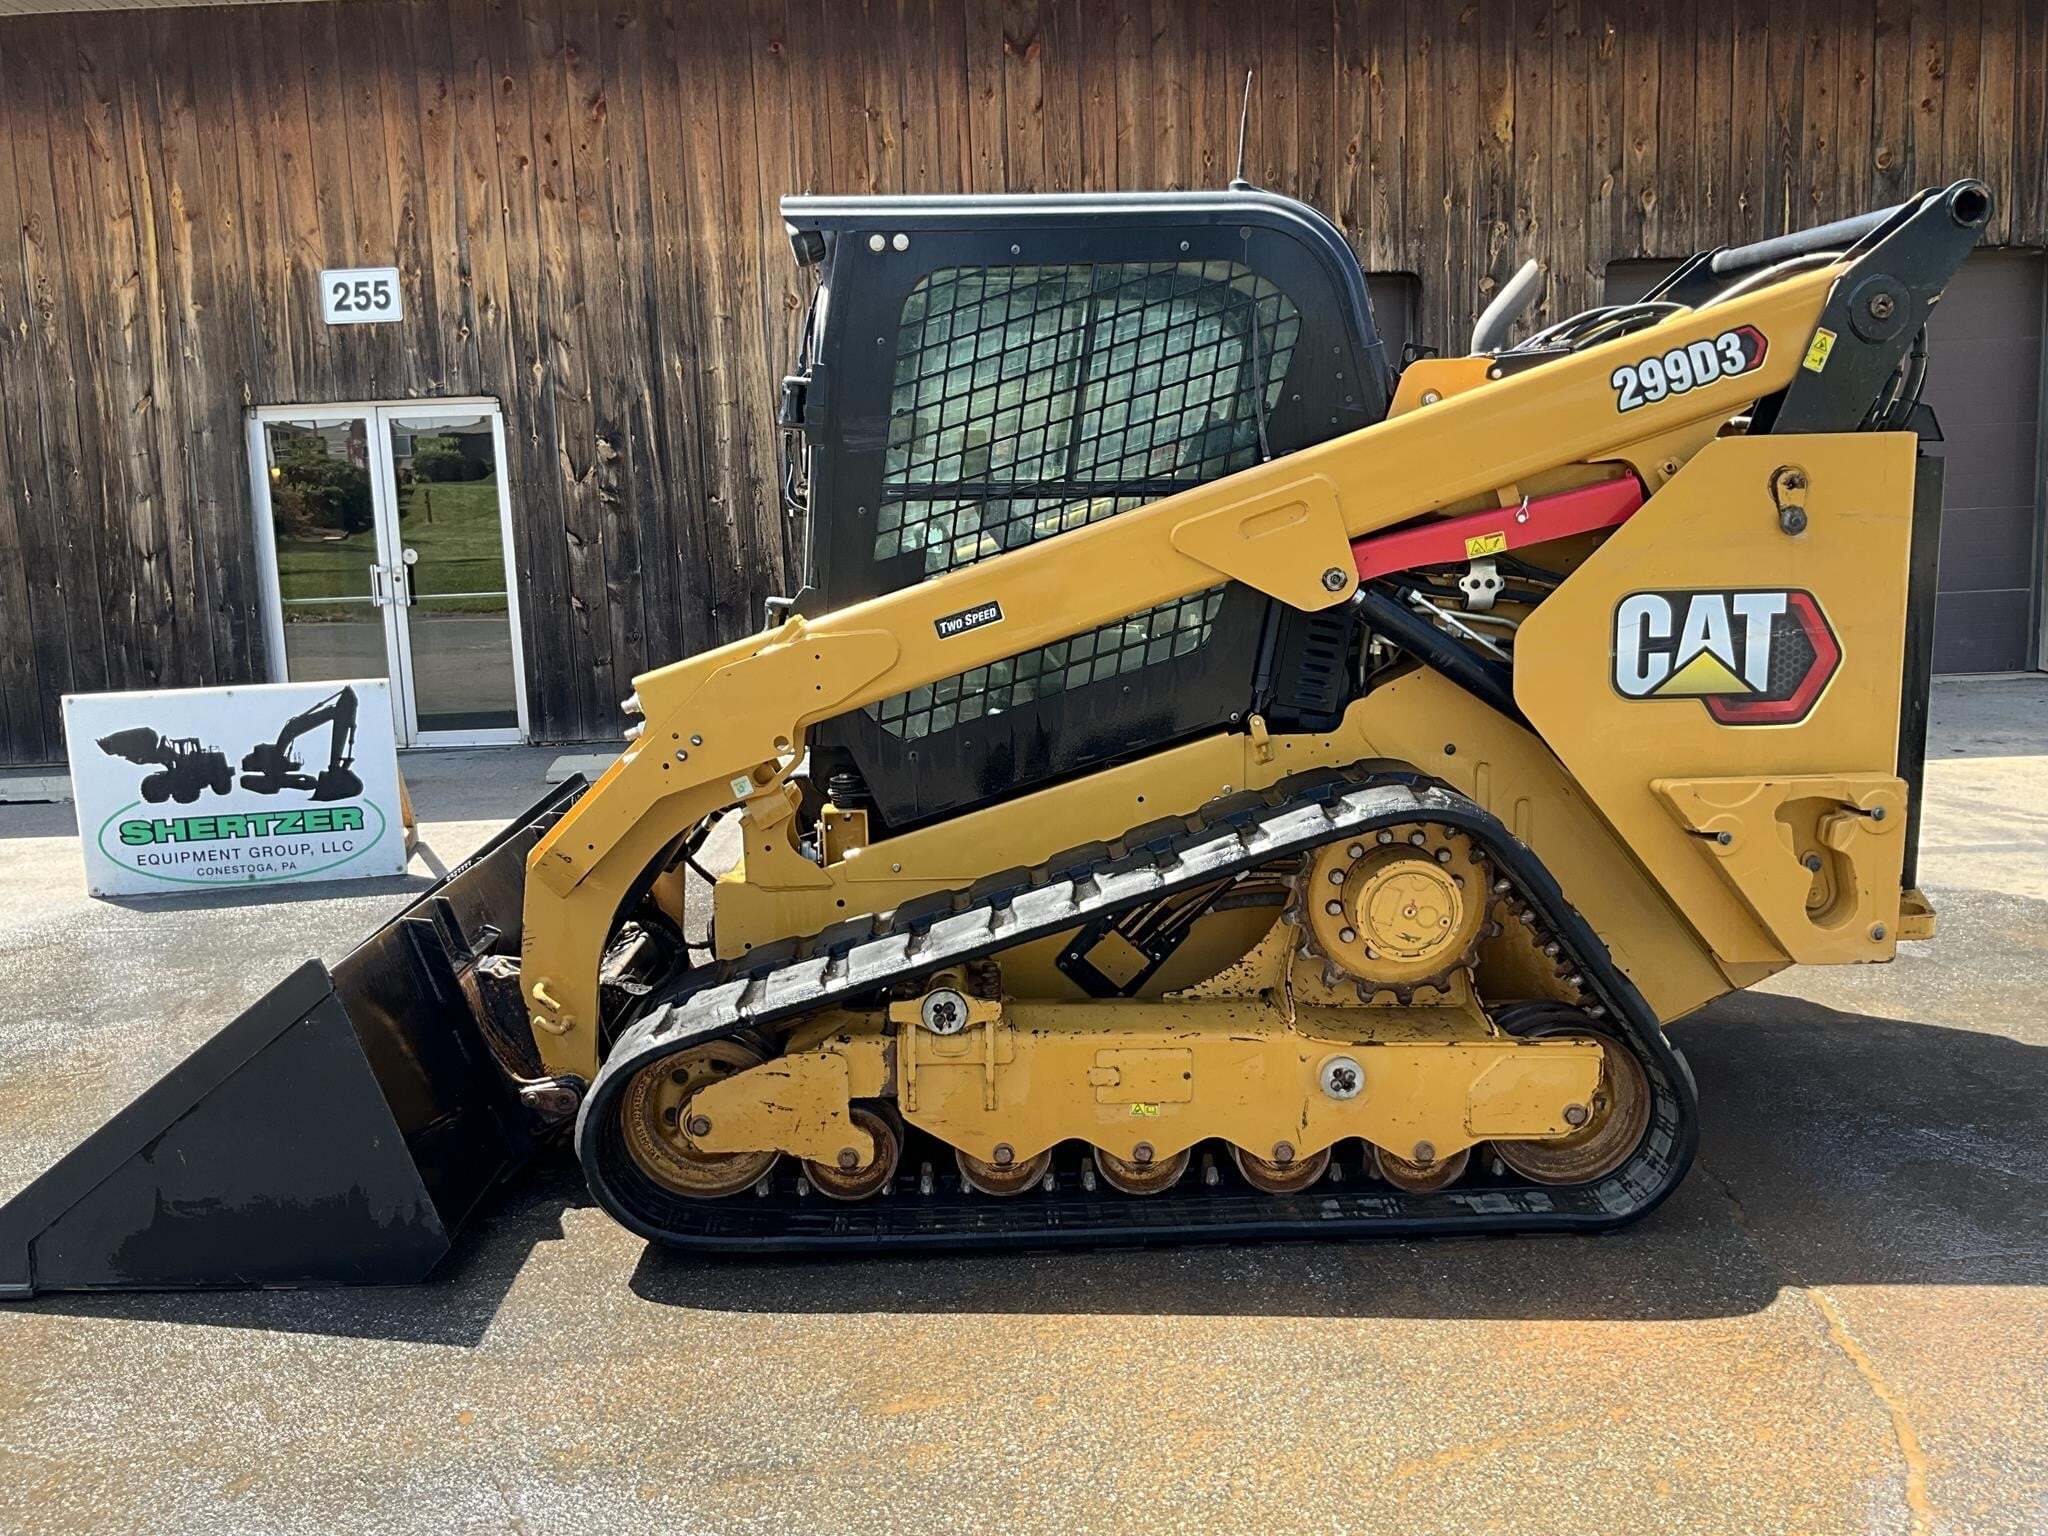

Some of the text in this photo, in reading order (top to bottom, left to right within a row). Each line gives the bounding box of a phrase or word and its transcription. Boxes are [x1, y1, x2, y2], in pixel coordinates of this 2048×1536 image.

[333, 280, 392, 312] 255
[1612, 331, 1747, 412] 299D3
[1616, 592, 1788, 697] CAT
[120, 806, 364, 845] SHERTZER
[137, 840, 354, 866] EQUIPMENT GROUP, LLC
[196, 861, 297, 877] CONESTOGA, PA
